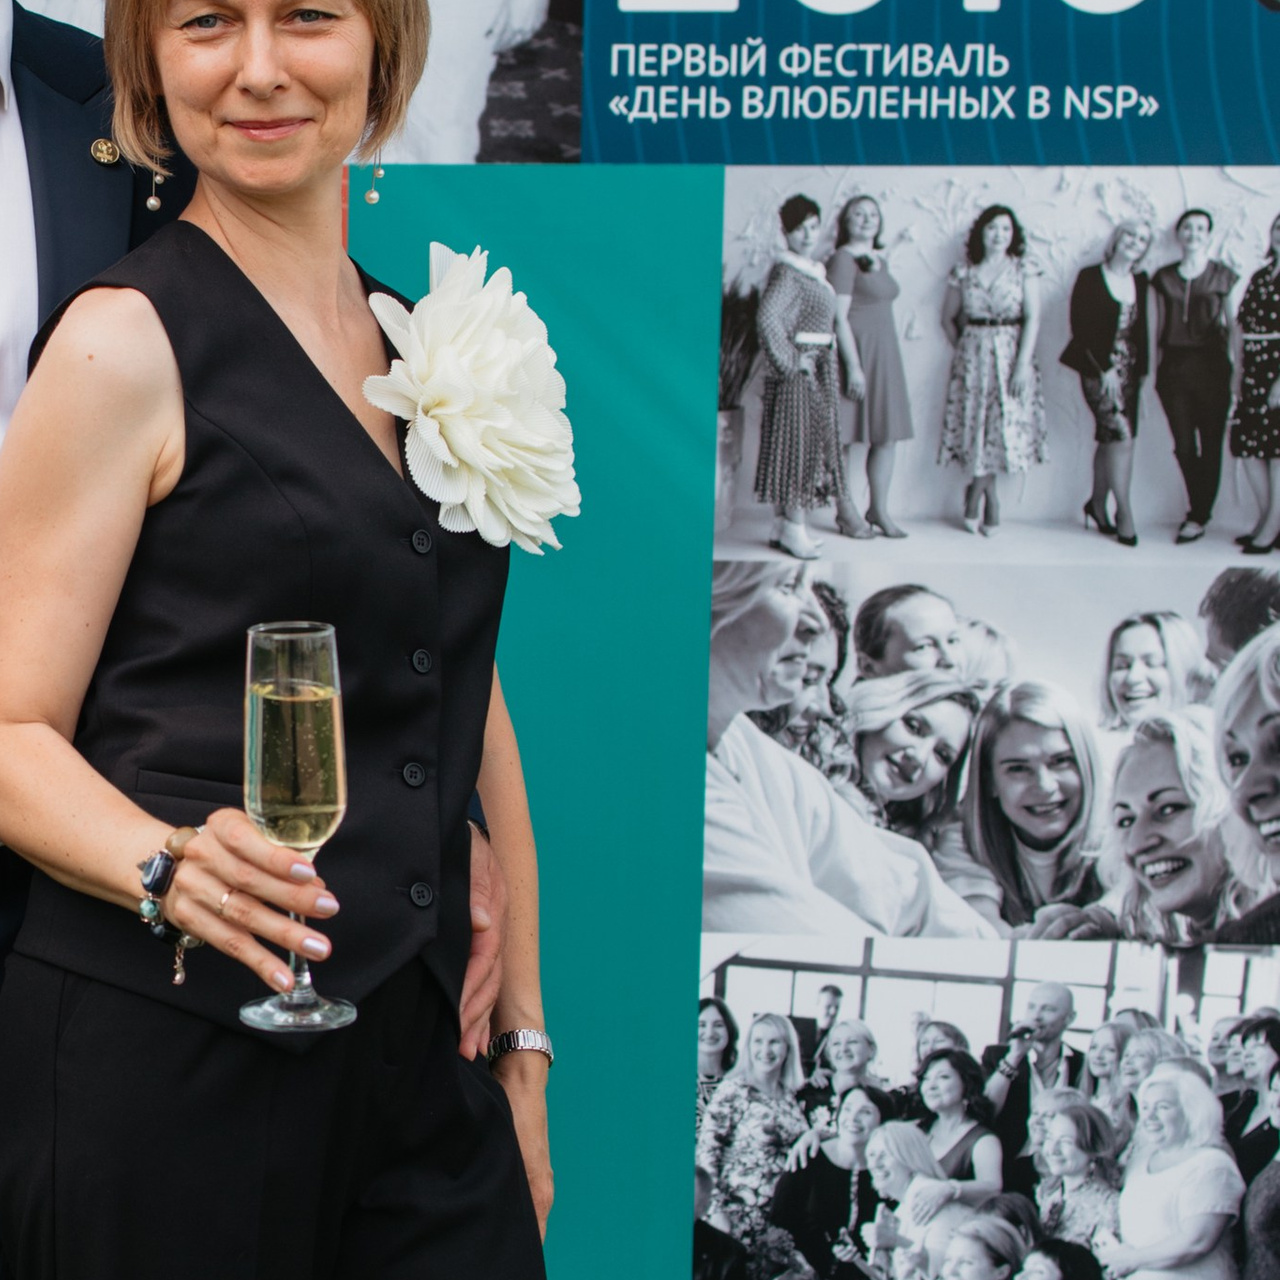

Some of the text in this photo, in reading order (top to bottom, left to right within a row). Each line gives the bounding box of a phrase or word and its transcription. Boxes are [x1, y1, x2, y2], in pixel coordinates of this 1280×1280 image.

[612, 37, 1009, 77] ПЕРВЫЙ ФЕСТИВАЛЬ
[609, 86, 1159, 123] «ДЕНЬ ВЛЮБЛЕННЫХ В NSP»
